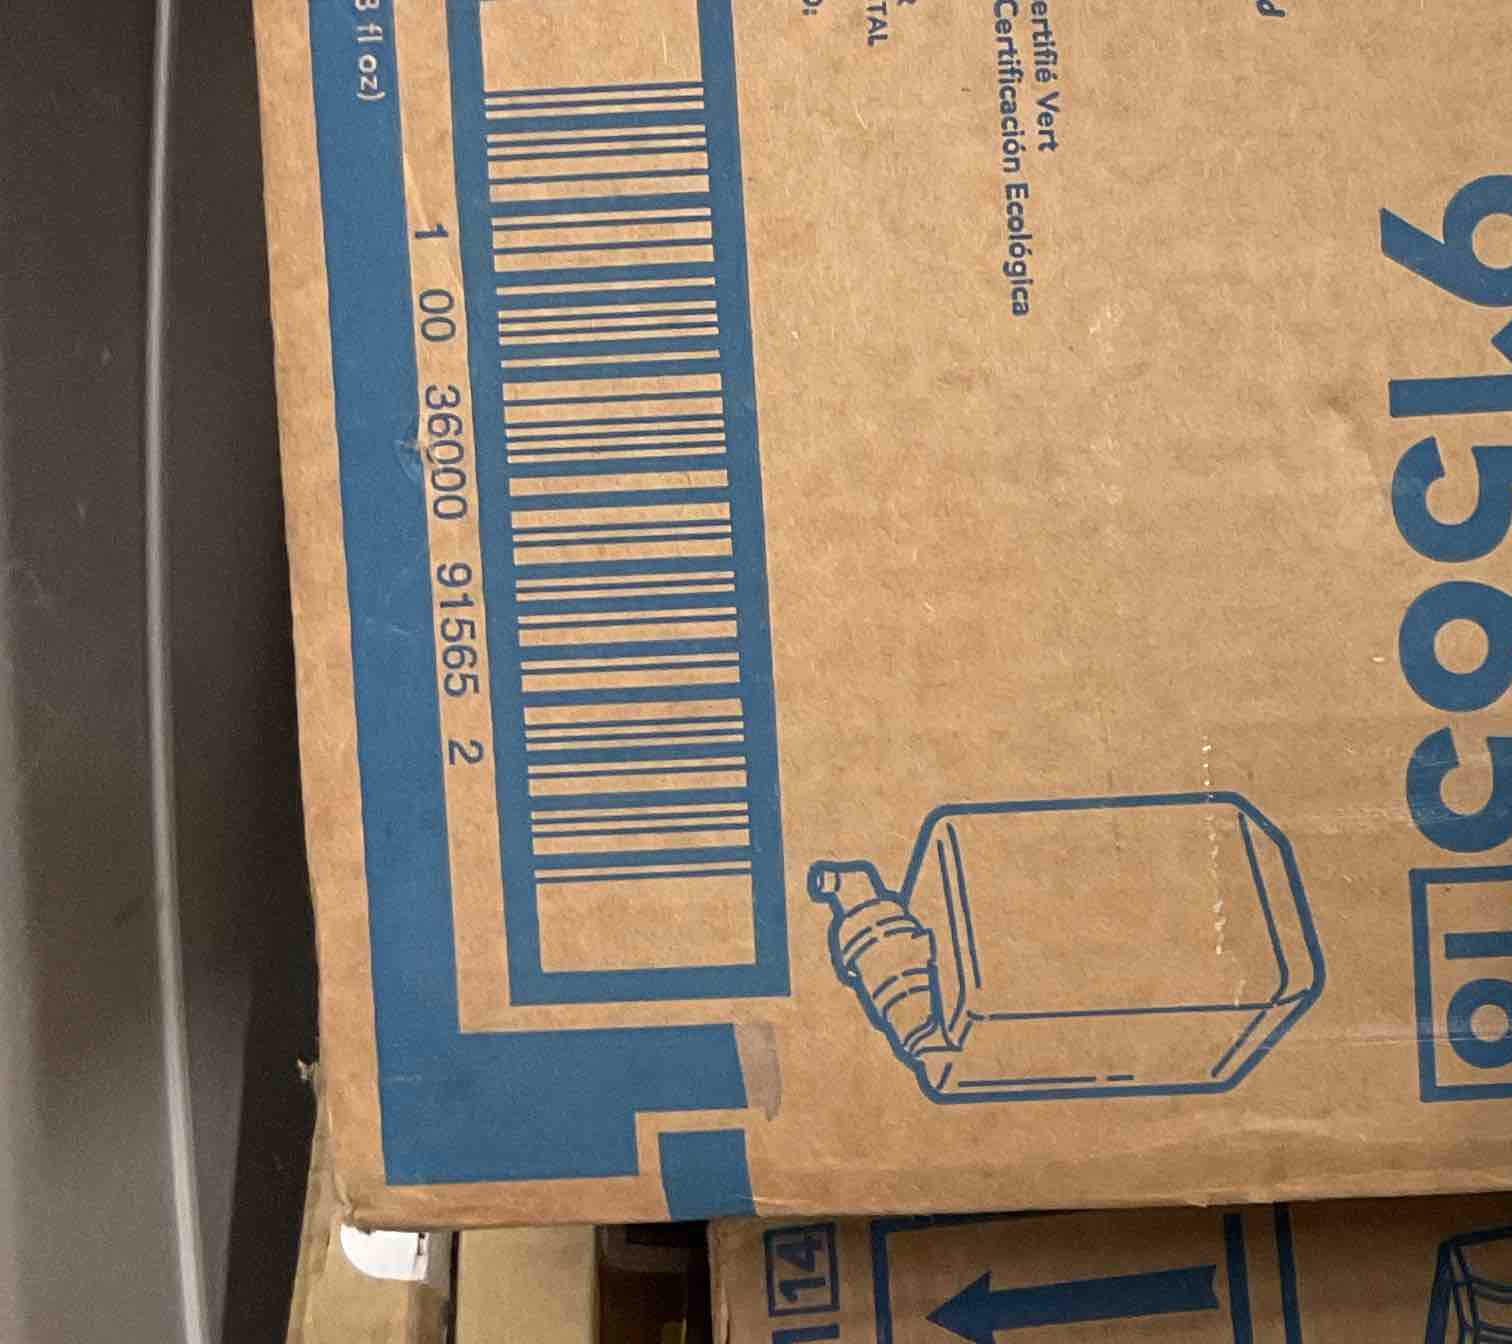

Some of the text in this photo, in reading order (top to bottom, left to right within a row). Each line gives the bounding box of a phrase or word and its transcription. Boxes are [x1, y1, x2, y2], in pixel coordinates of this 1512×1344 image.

[357, 24, 382, 43] fl
[357, 55, 384, 101] oz)
[1038, 91, 1060, 151] Vert
[1002, 183, 1033, 316] Ecológica
[415, 224, 484, 766] 1 00 36000 91565 2
[779, 1237, 826, 1302] 14
